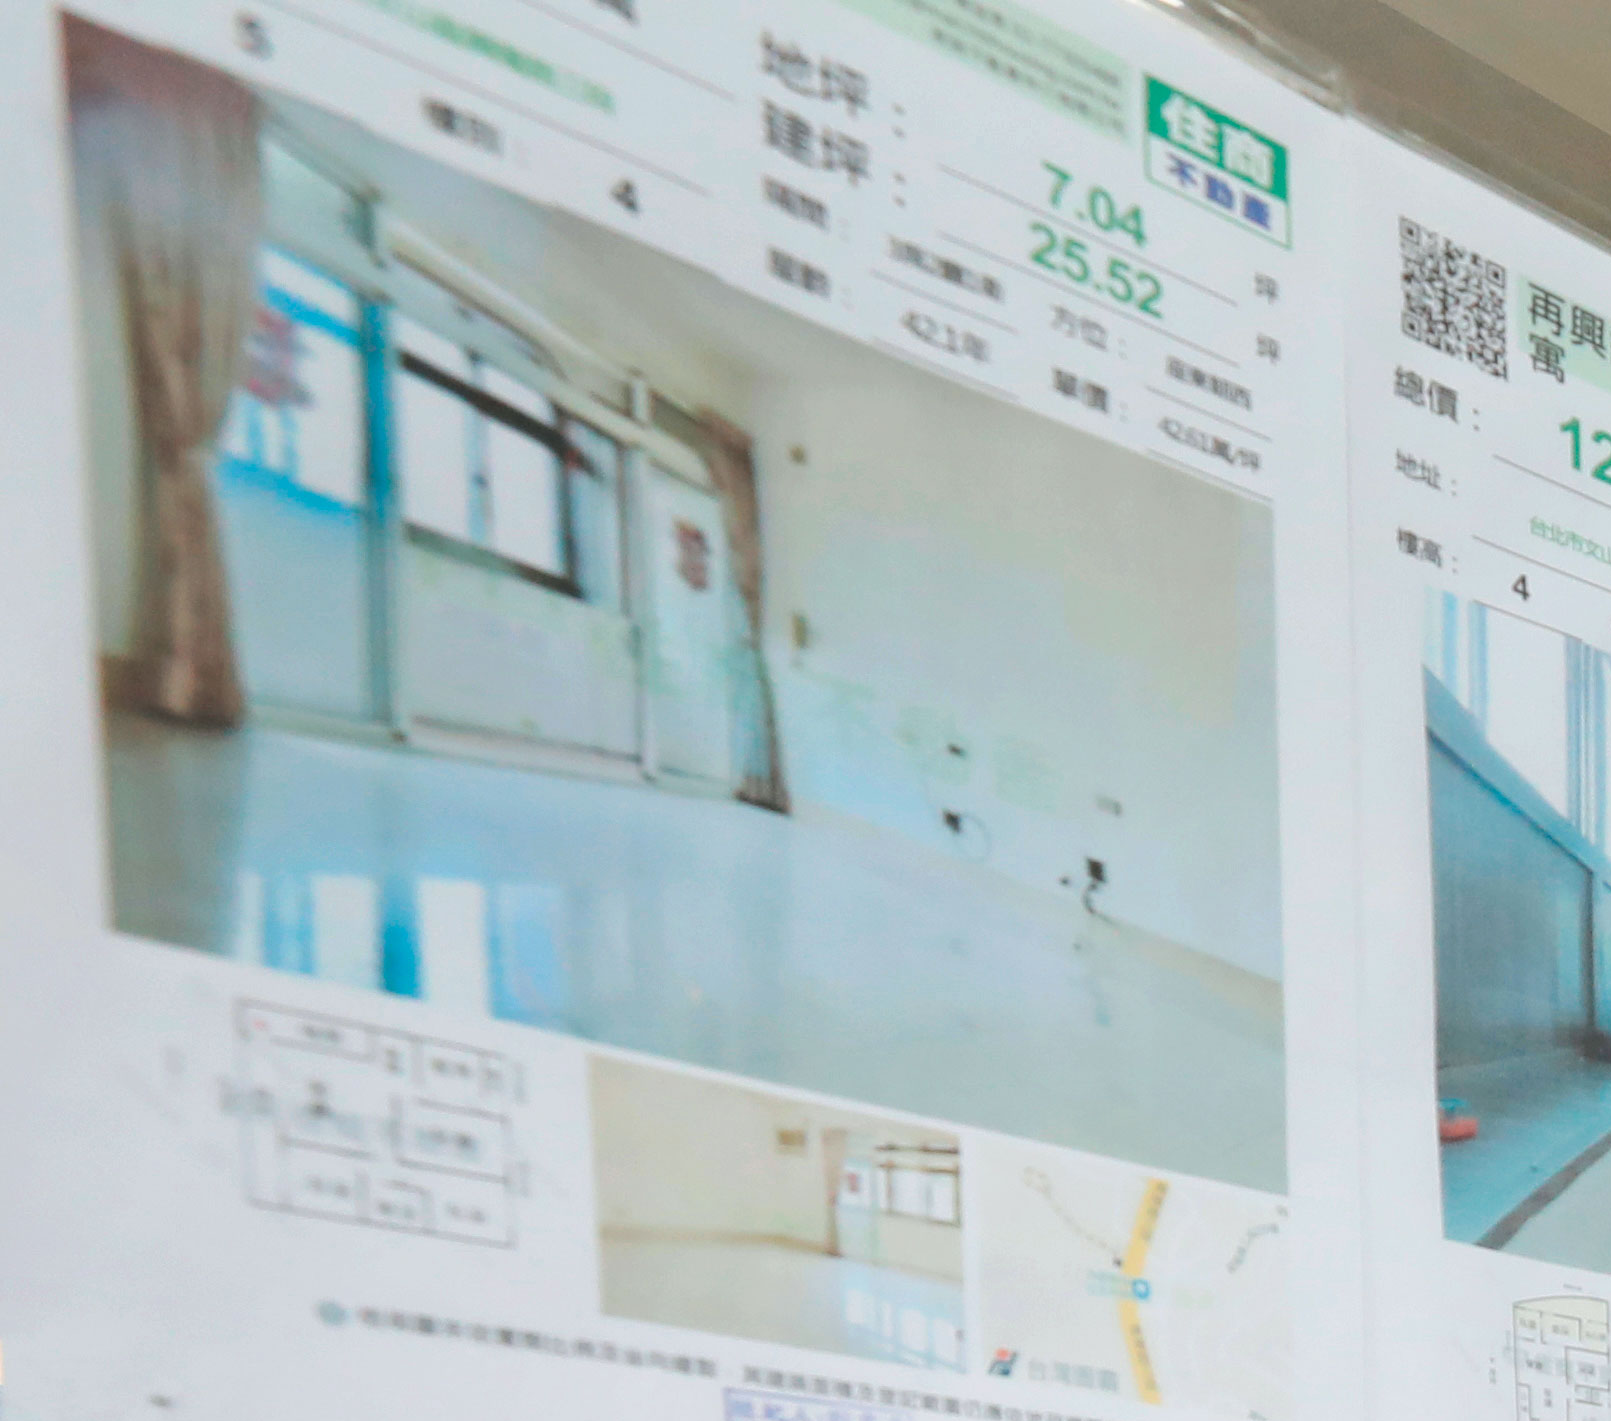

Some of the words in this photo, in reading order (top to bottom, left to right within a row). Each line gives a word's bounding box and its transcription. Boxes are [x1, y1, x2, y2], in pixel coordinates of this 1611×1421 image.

[1160, 88, 1276, 190] 住商
[1042, 160, 1147, 248] 7.04
[1165, 153, 1273, 230] 不動產
[1030, 222, 1165, 320] 25.52
[1511, 574, 1531, 601] 4
